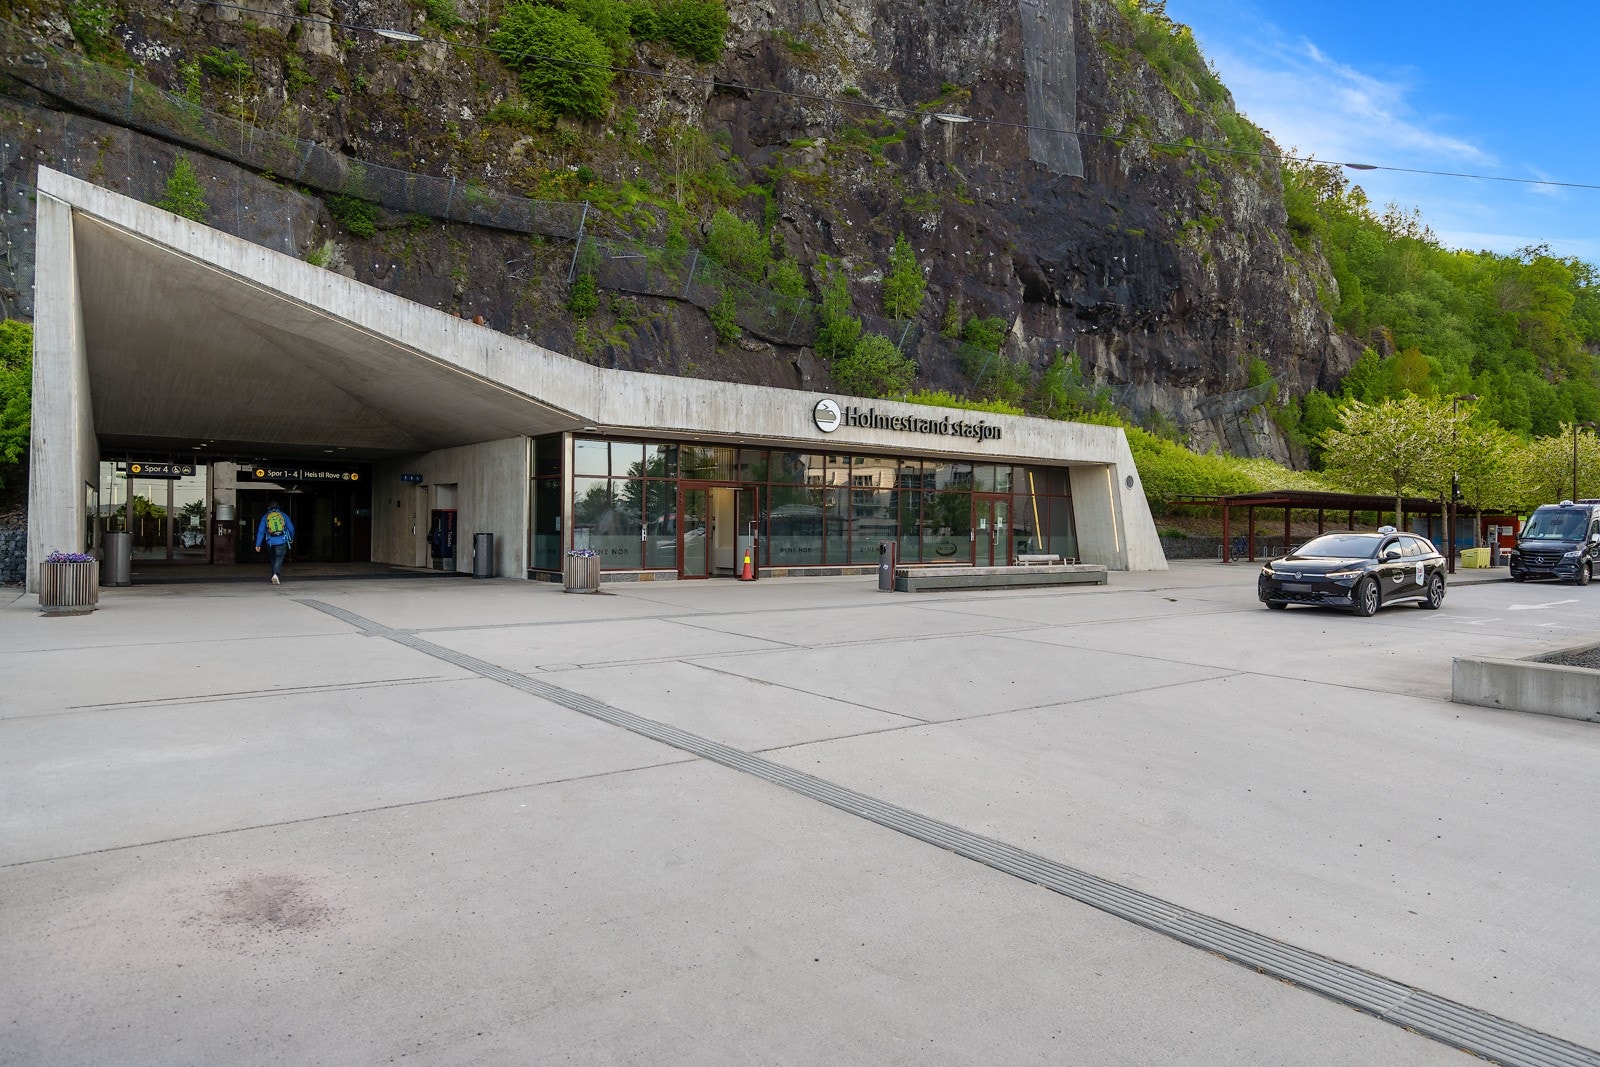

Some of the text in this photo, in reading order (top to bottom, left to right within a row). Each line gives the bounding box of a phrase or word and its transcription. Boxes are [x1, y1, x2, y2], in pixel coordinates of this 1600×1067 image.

[845, 405, 1002, 443] Holmestrand stasjon
[144, 464, 169, 474] Spor 4
[267, 469, 282, 478] Spor
